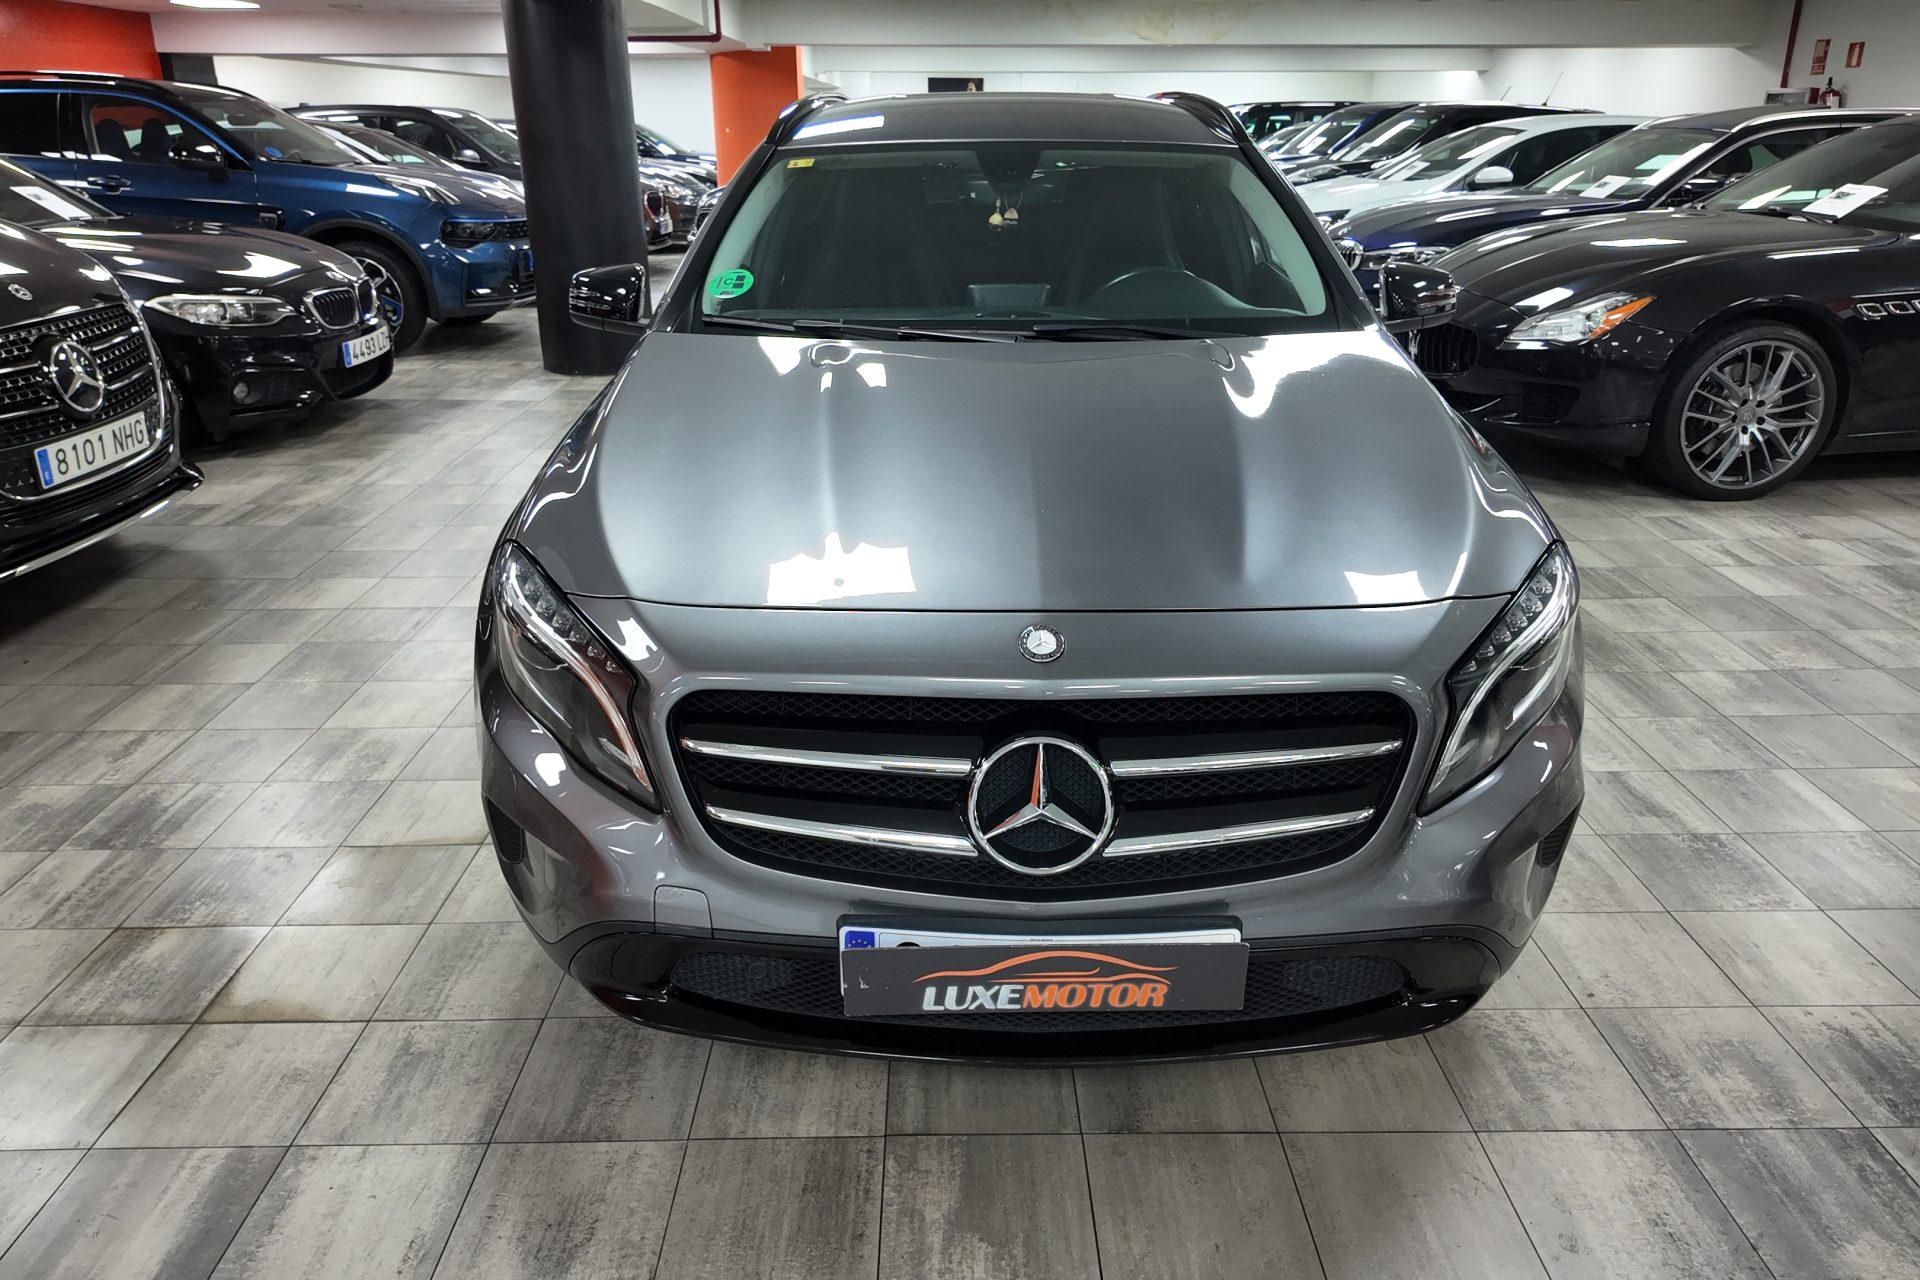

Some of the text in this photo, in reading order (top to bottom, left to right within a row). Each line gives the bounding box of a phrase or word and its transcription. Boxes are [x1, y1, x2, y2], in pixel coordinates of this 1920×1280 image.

[352, 336, 377, 361] 4493
[55, 419, 145, 476] 8101 NHG
[922, 983, 1168, 1011] LUXEMOTOR
